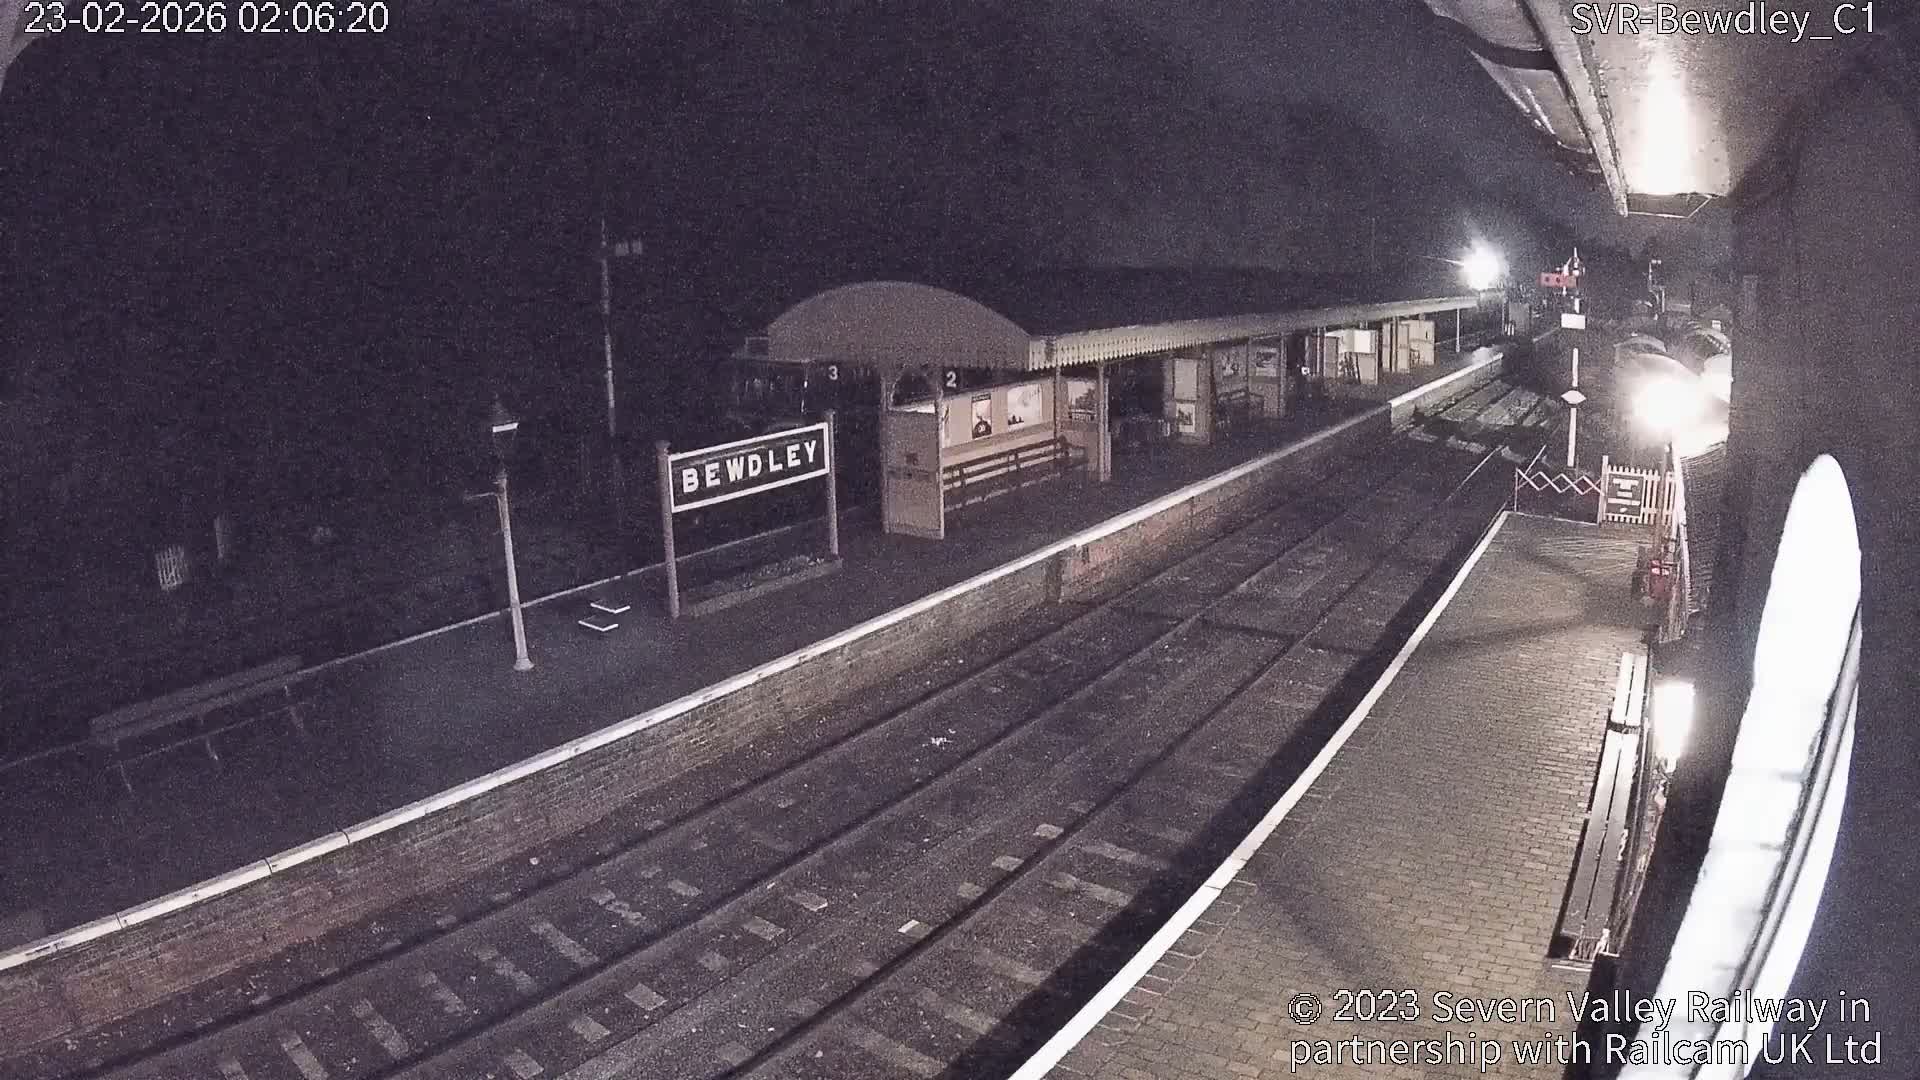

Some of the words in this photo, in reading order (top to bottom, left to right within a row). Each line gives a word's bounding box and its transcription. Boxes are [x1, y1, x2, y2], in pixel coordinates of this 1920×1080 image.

[828, 366, 839, 380] 3
[946, 373, 957, 388] 2
[682, 440, 817, 493] BEWDLEY
